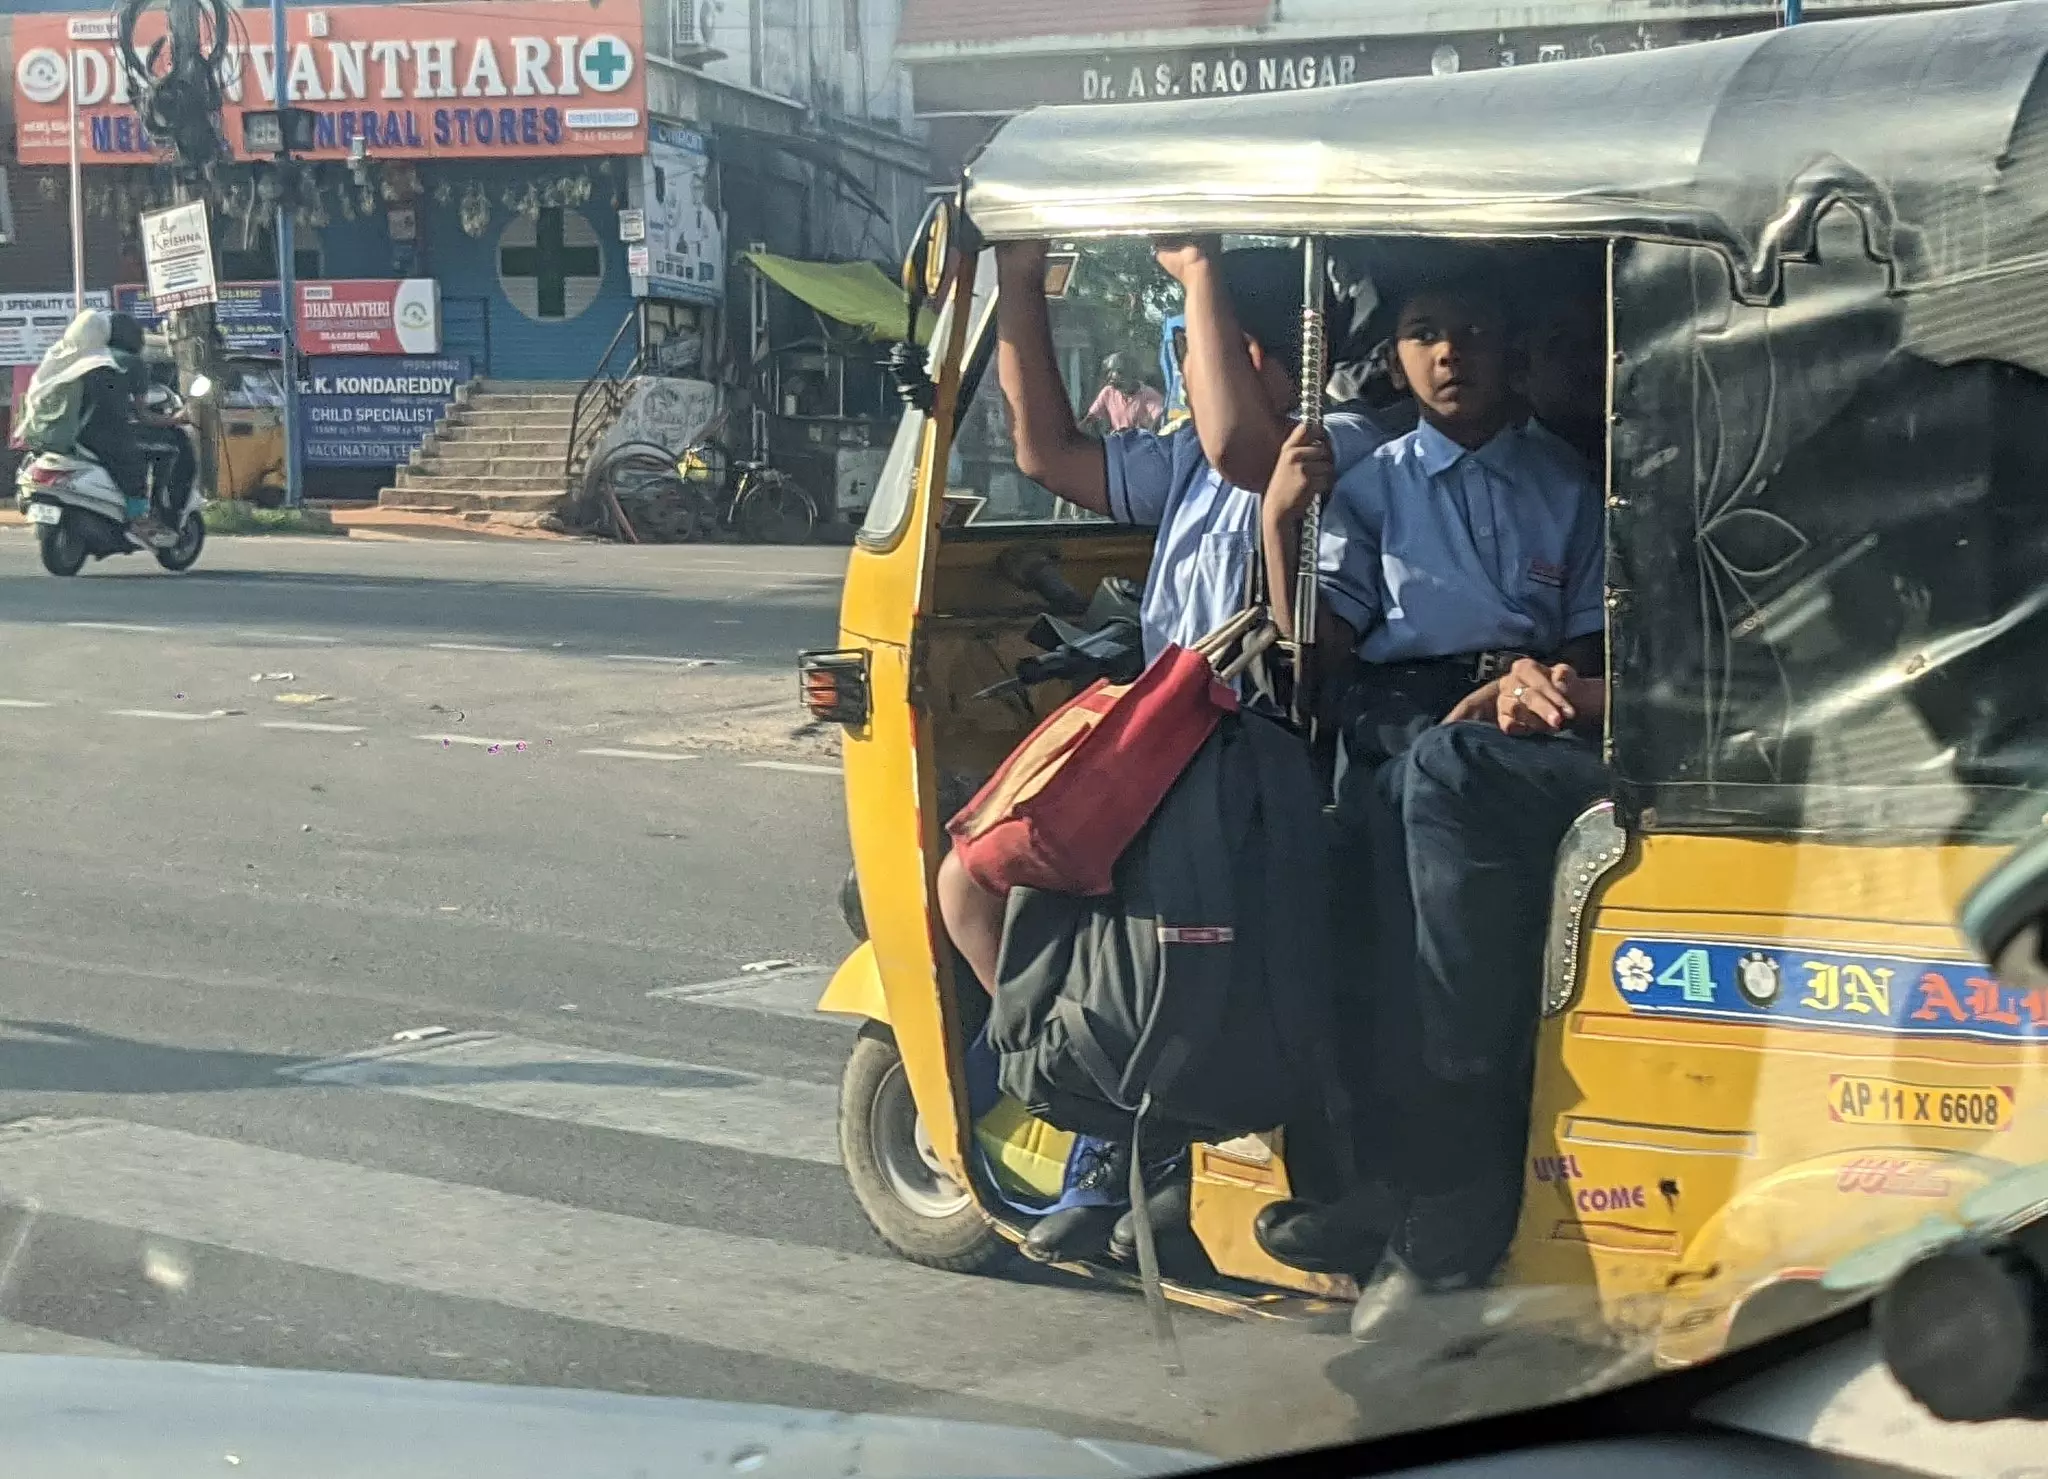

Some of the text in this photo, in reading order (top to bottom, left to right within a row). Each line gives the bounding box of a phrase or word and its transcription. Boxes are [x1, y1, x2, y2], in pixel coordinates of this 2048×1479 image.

[1083, 70, 1116, 99] Dr.
[1191, 59, 1248, 93] RAO
[1258, 55, 1357, 90] NAGAR
[433, 106, 563, 146] STORES
[303, 301, 391, 318] DHANVANTHRI
[315, 378, 333, 394] K.
[337, 377, 455, 395] KONDAREDDY
[312, 408, 434, 422] CHILD SPECIALIST
[1656, 949, 1718, 1004] 4
[1840, 1081, 1999, 1126] AP 11 X 6608
[1577, 1184, 1646, 1213] COME
